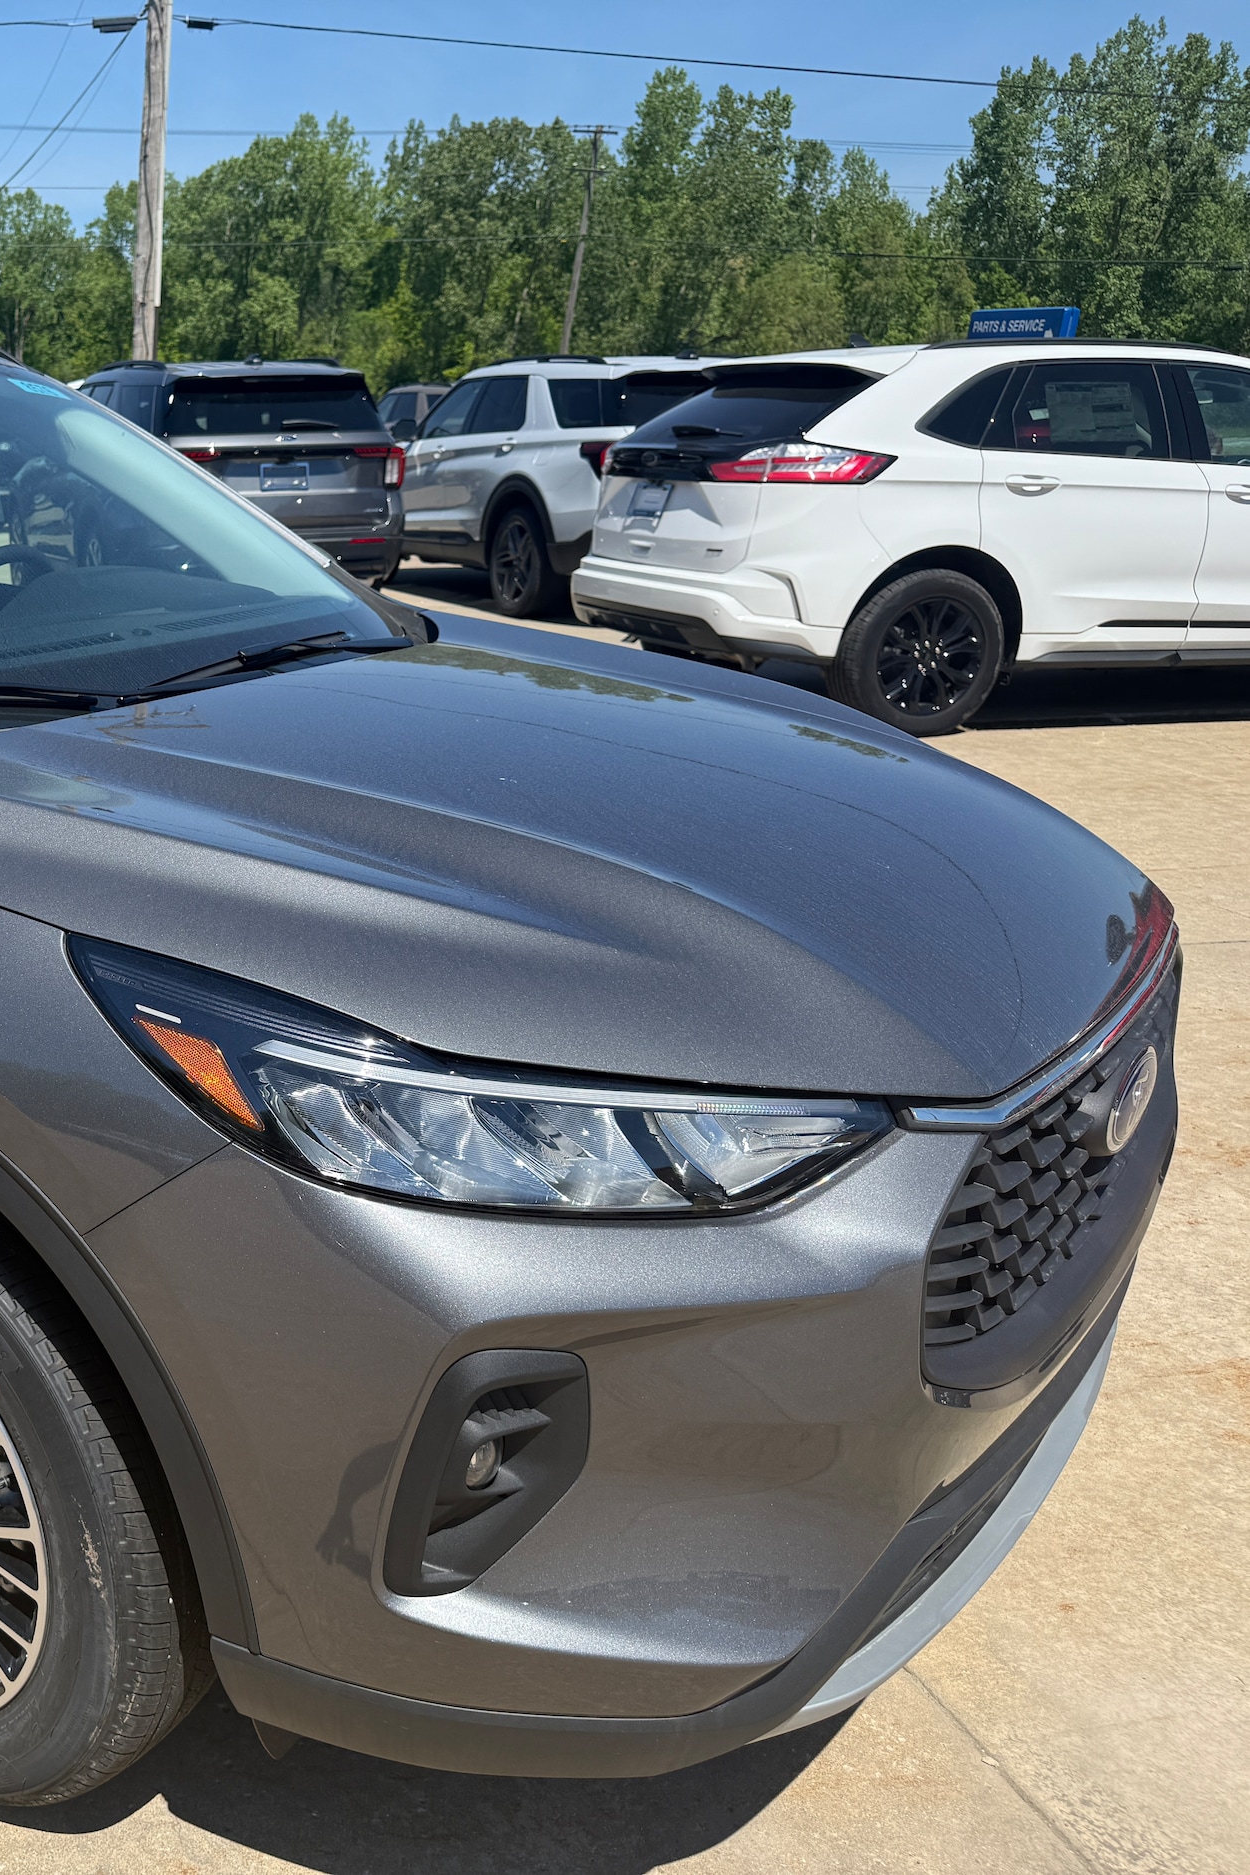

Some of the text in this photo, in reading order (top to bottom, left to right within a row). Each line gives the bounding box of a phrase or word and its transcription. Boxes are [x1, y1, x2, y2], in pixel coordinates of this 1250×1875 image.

[972, 318, 1046, 333] PARTS & SERVICE
